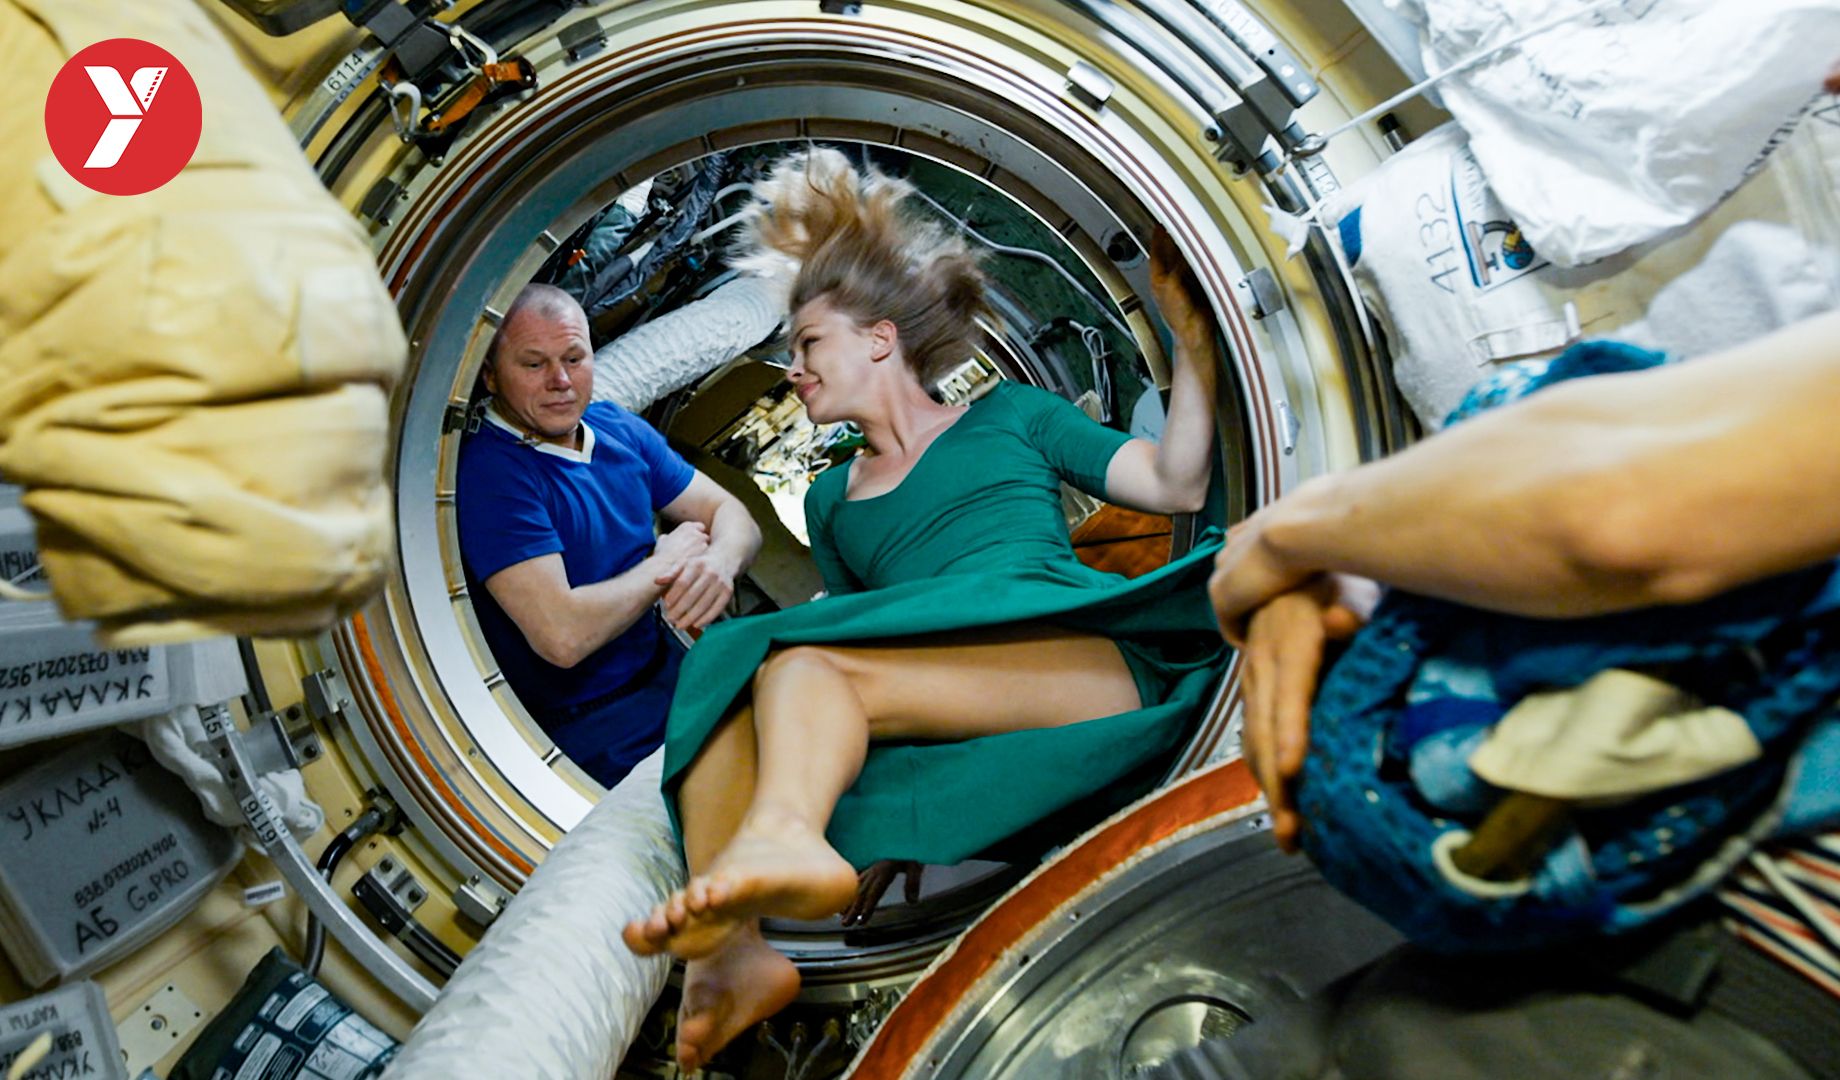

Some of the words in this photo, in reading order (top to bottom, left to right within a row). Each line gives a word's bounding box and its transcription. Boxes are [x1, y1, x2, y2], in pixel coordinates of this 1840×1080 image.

[327, 52, 364, 91] 6114
[1415, 184, 1460, 294] 4132
[244, 800, 278, 843] 6116
[76, 906, 119, 954] АБ
